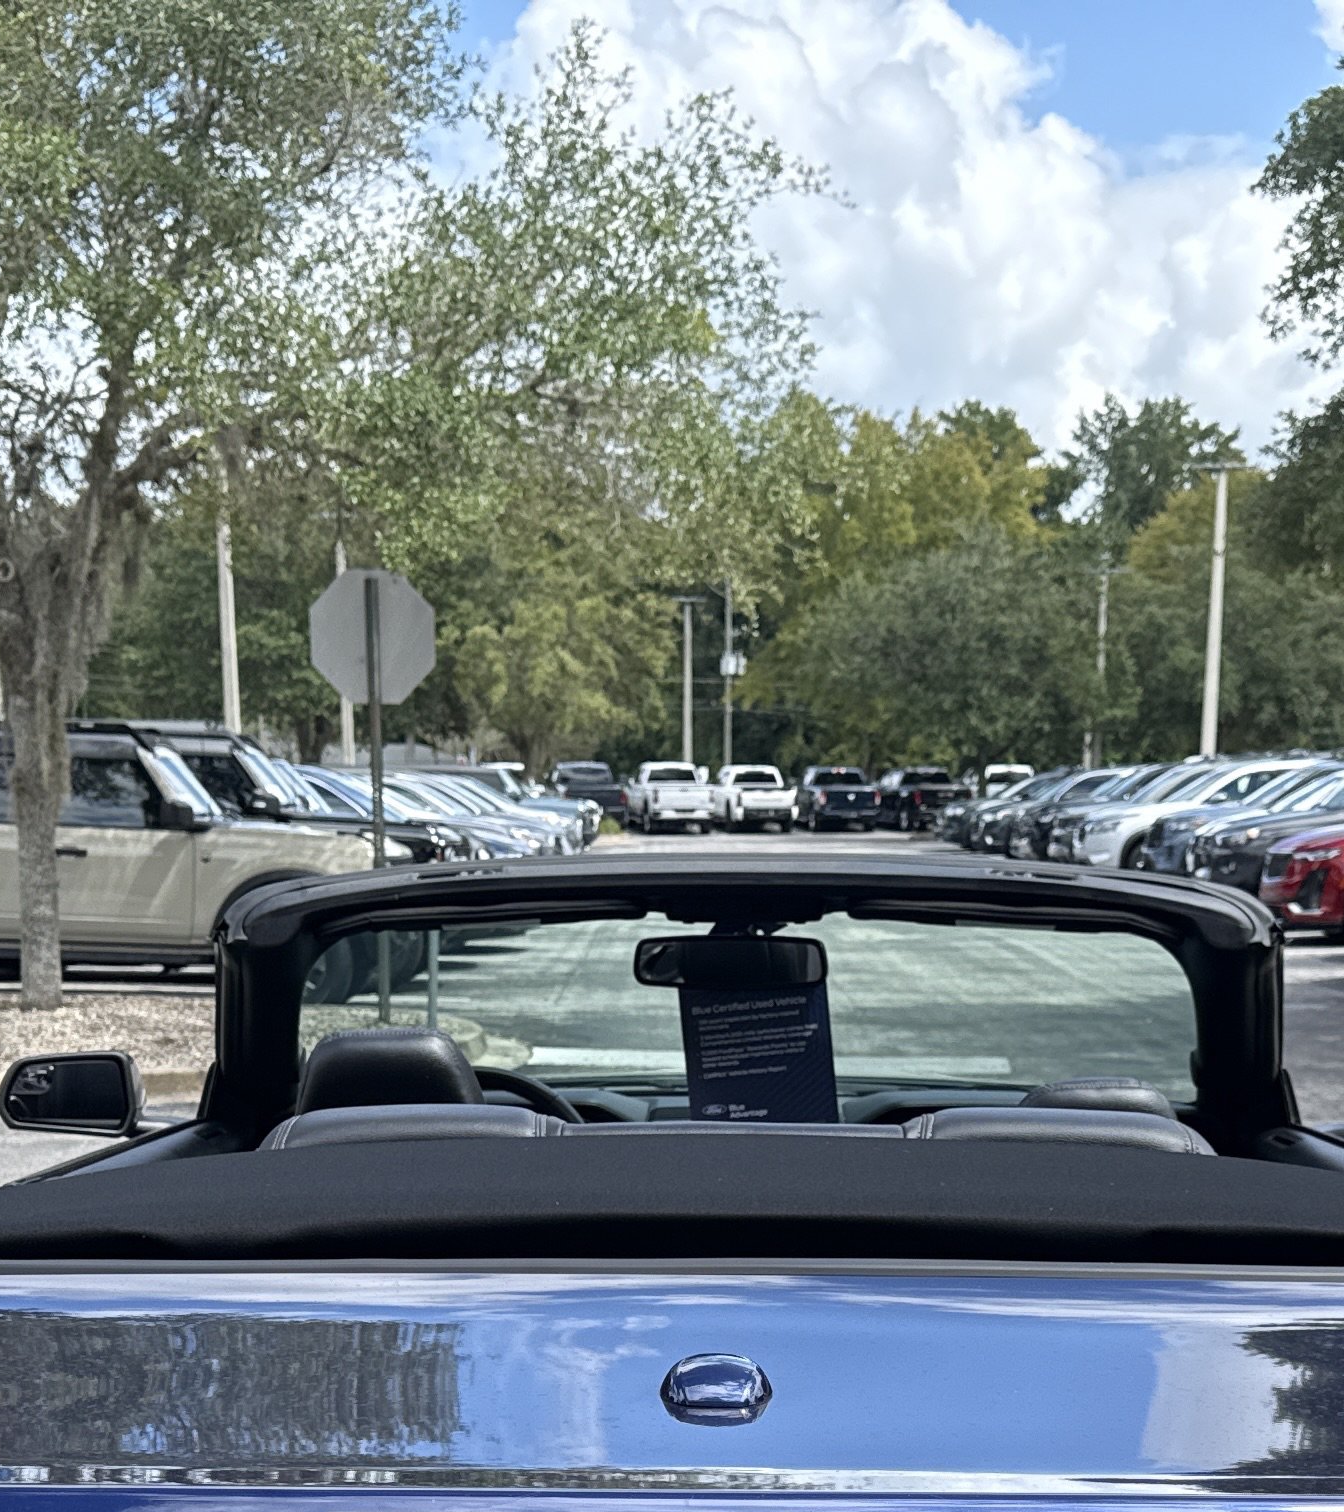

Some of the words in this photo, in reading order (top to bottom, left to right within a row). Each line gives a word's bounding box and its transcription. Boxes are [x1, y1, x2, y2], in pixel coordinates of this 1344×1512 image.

[692, 1006, 711, 1015] Blue
[713, 1002, 750, 1013] Certified
[751, 999, 774, 1009] Used
[775, 997, 806, 1006] Vehicle
